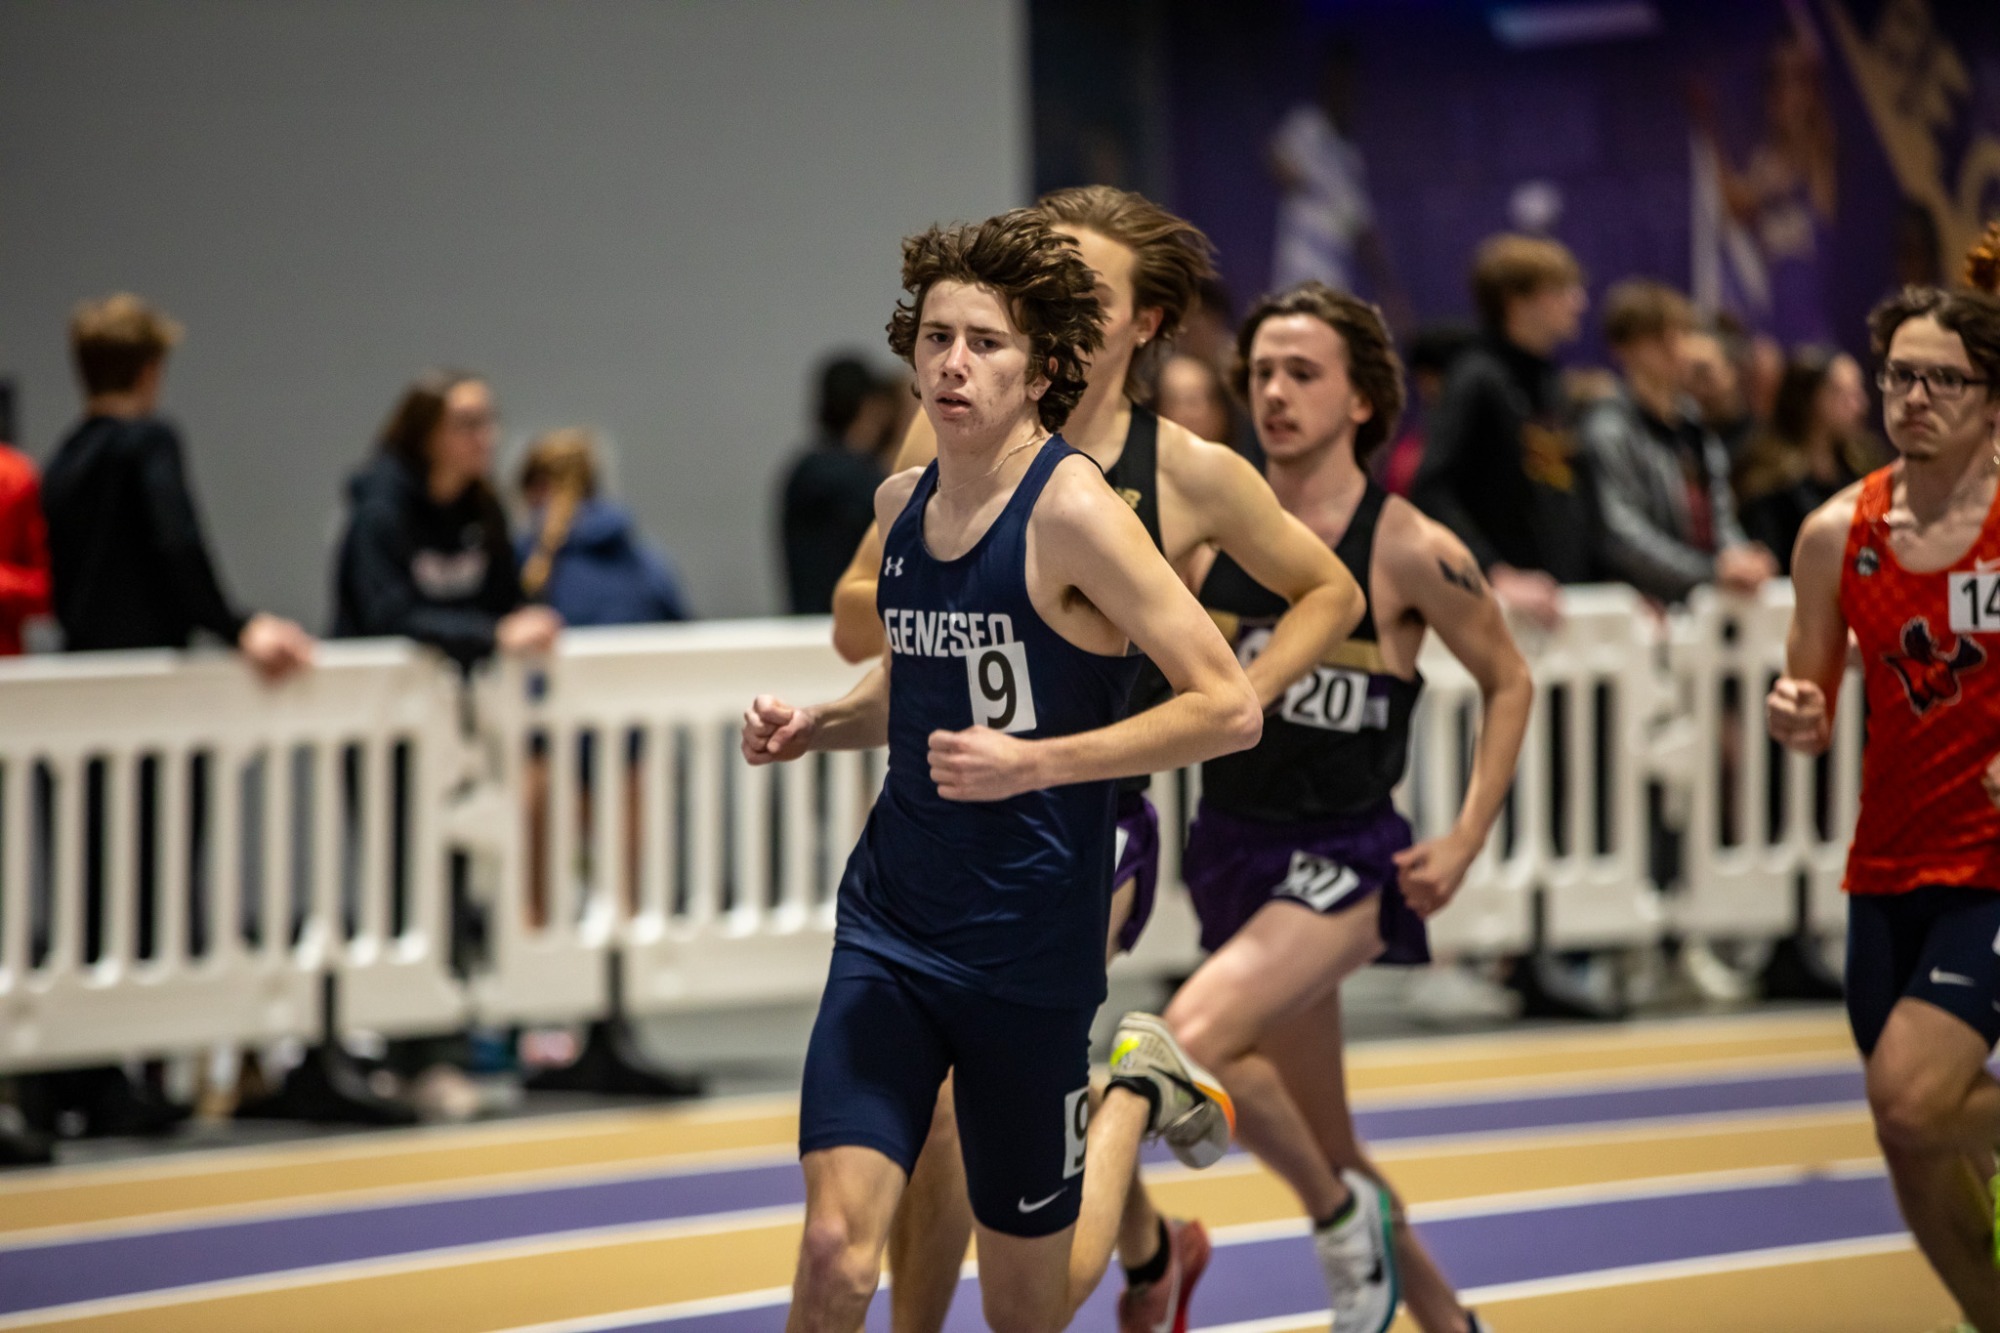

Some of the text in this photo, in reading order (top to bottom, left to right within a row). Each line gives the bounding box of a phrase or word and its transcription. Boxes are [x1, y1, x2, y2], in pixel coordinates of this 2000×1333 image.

[884, 608, 1014, 657] GENESEO
[978, 650, 1017, 730] 9
[1292, 672, 1353, 724] 20
